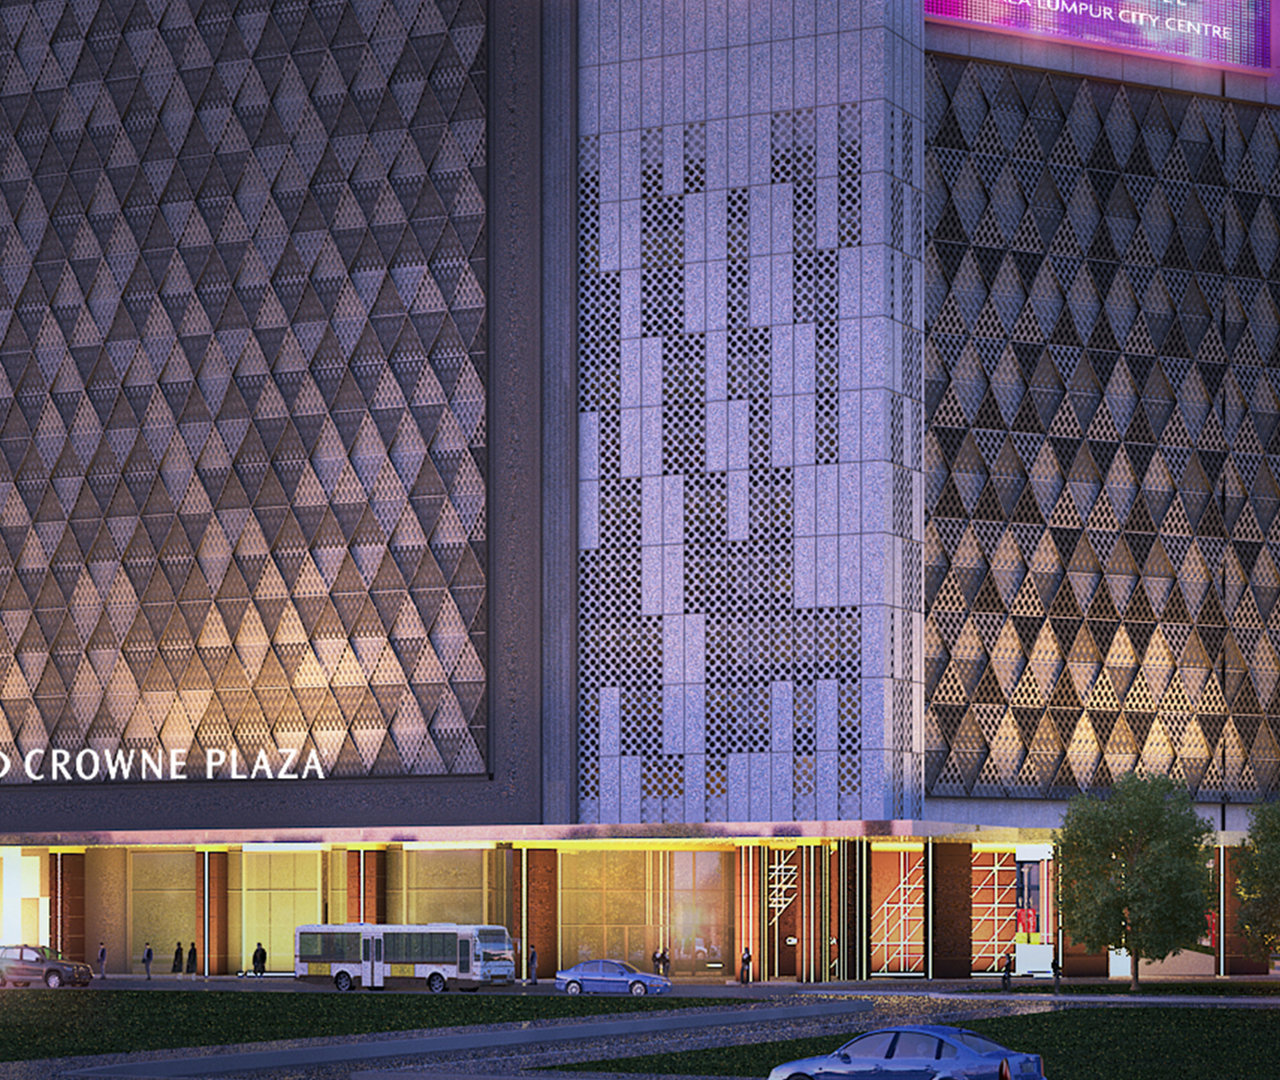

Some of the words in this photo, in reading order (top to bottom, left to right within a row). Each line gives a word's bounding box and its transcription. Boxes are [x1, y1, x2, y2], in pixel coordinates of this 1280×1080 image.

[1118, 9, 1160, 28] CITY
[1165, 17, 1233, 41] CENTRE
[24, 748, 187, 780] CROWNE
[206, 748, 326, 780] PLAZA
